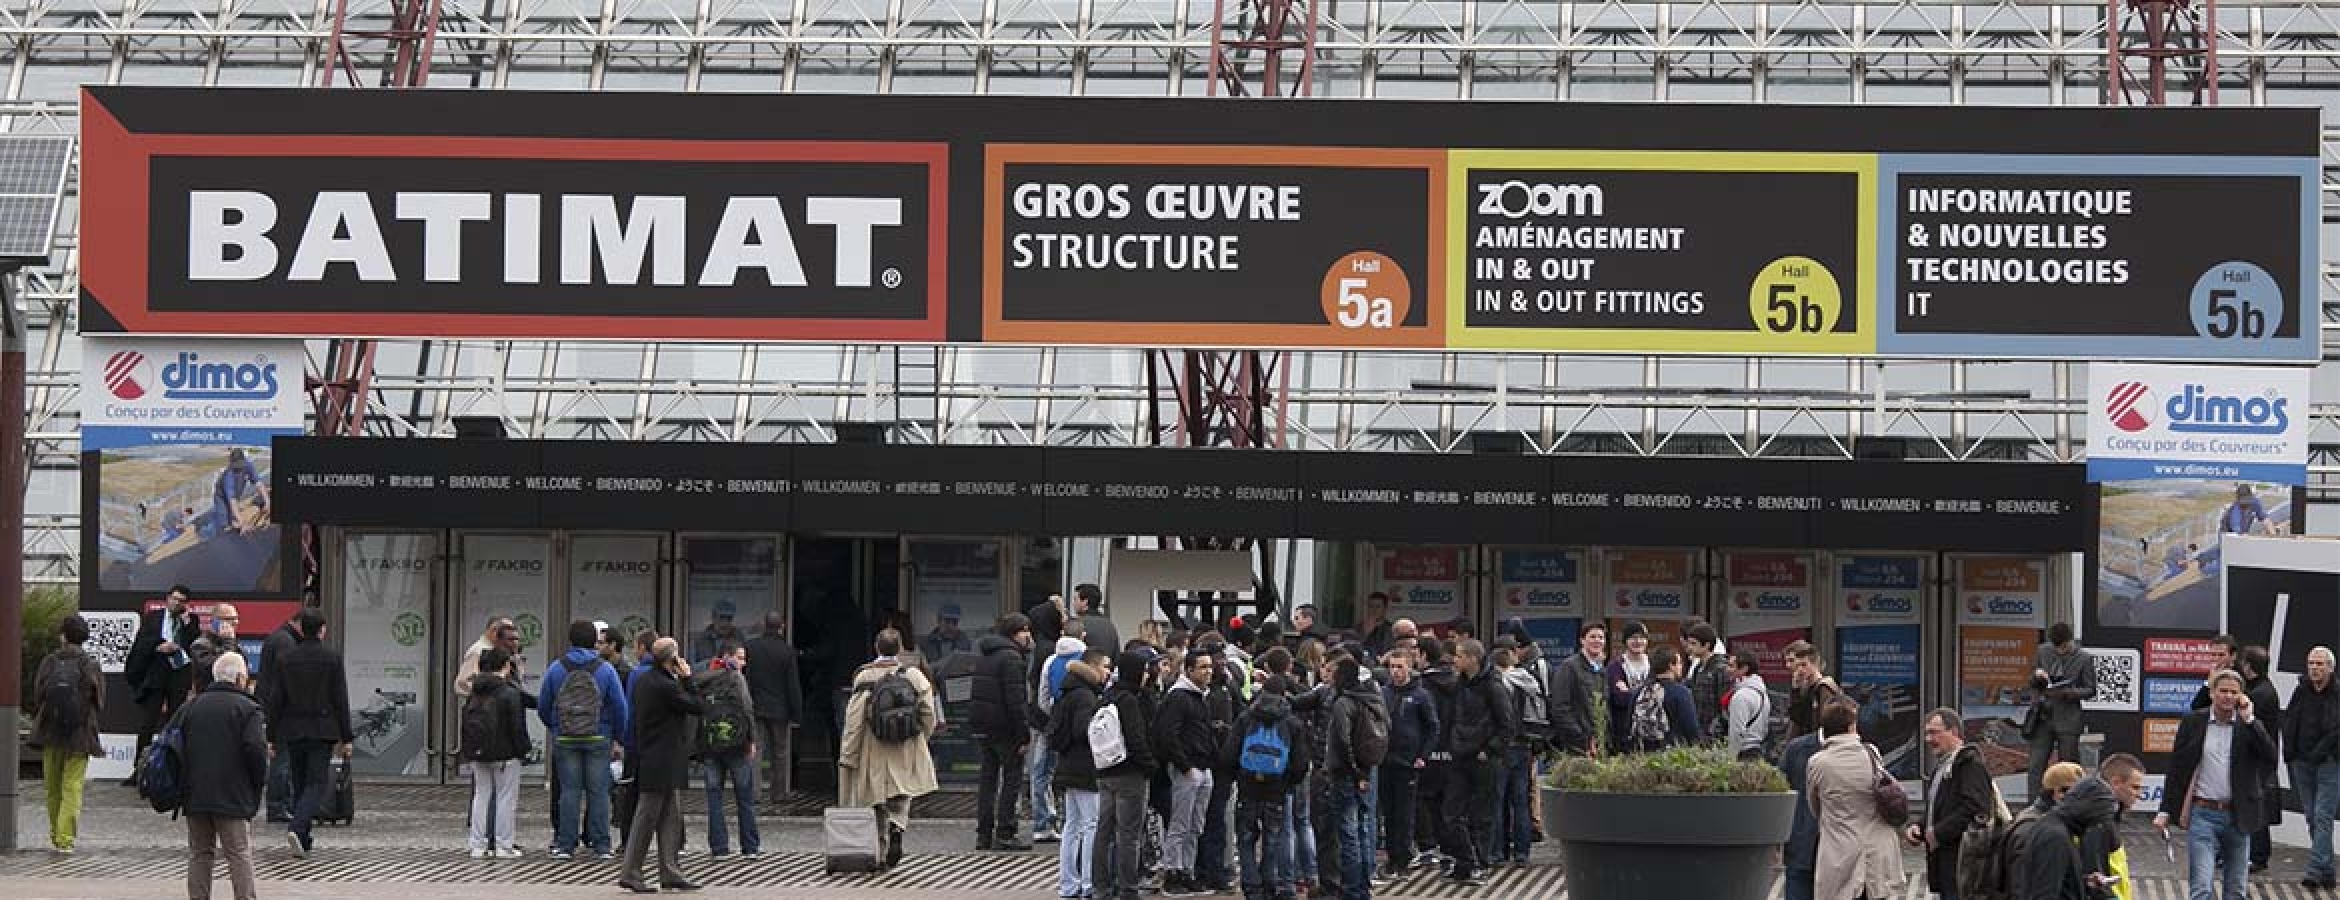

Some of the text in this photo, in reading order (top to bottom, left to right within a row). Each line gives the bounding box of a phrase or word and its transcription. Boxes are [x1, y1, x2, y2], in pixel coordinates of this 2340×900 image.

[1013, 183, 1301, 221] GROS ŒUVRE
[1908, 189, 2132, 217] INFORMATIQUE
[1475, 222, 1685, 250] AMÉNAGEMENT
[1907, 224, 2108, 249] & NOUVELLES
[1012, 233, 1240, 270] STRUCTURE
[1351, 259, 1381, 273] Hall
[1475, 257, 1595, 281] IN & OUT
[1782, 264, 1809, 277] Hall
[1907, 257, 2129, 284] TECHNOLOGIES
[2222, 269, 2251, 283] Hall
[1336, 278, 1393, 328] 5a
[1475, 290, 1704, 314] IN & OUT FITTINGS
[1766, 283, 1824, 333] 5b
[1907, 291, 1932, 316] IT
[2207, 289, 2265, 338] 5b
[161, 352, 278, 400] dimos
[105, 404, 148, 420] Conçu
[151, 405, 173, 419] par
[177, 404, 200, 418] des
[2165, 384, 2289, 434] dimos
[151, 430, 233, 442] www.dimos.eu
[2107, 435, 2150, 453] Conçu
[2155, 438, 2177, 453] par
[2181, 438, 2206, 453] des
[2153, 463, 2239, 477] www.dimos.eu
[298, 473, 375, 487] WILLKOMMEN
[449, 475, 511, 489] BIENVENUE
[525, 476, 583, 490] WELCOME
[595, 477, 663, 491] BIENVENIDO
[727, 479, 791, 493] BENVENUTI
[801, 479, 881, 493] WILLKOMMEN
[955, 481, 1017, 495] BIENVENUE
[1029, 482, 1090, 497] WELCOME
[1105, 483, 1169, 498] BIENVENIDO
[1235, 486, 1303, 501] BENVENUTI
[1321, 489, 1399, 502] WILLKOMMEN
[1473, 491, 1537, 505] BIENVENUE
[1551, 492, 1609, 507] WELCOME
[1623, 493, 1691, 508] BIENVENIDO
[1757, 495, 1822, 510] BENVENUTI
[1840, 497, 1921, 512] WILLKOMMEN
[1996, 499, 2060, 514] BIENVENUE
[487, 559, 542, 571] FAKRO
[594, 560, 651, 573] FAKRO
[1408, 586, 1453, 604] dimos
[1527, 587, 1571, 606] dimos
[1636, 589, 1680, 608] dimos
[1756, 591, 1800, 610] dimos
[1868, 594, 1912, 613] dimos
[1988, 596, 2033, 614] dimos
